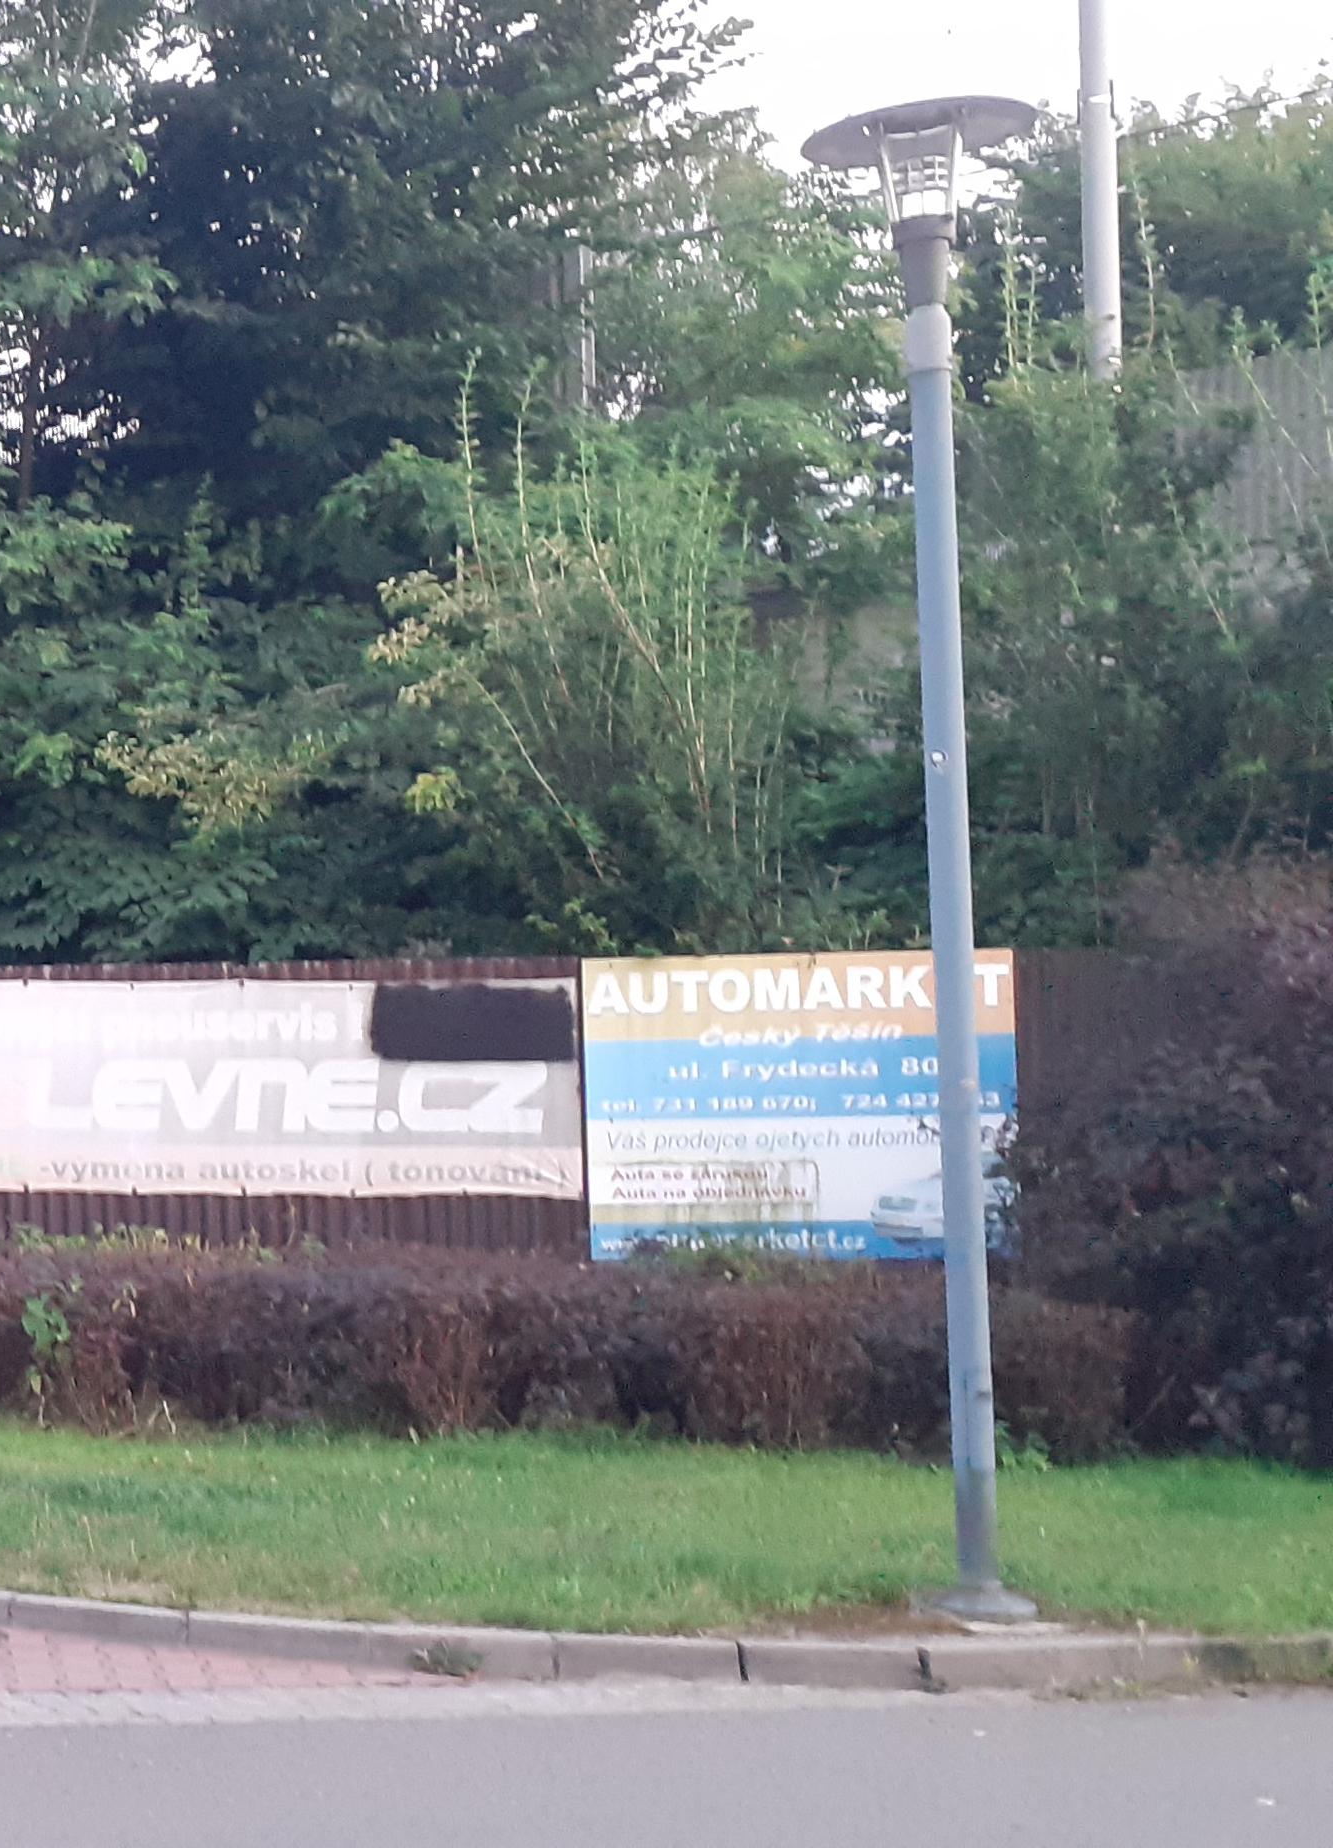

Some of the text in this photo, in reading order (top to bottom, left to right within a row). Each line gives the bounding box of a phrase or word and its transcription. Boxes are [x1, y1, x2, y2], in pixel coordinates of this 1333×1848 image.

[587, 963, 1010, 1016] AUTOMARKT
[698, 1020, 904, 1049] Český Těšín
[654, 1130, 747, 1154] prodejce
[756, 1129, 840, 1154] ojetých
[611, 1167, 656, 1182] Auta
[612, 1186, 656, 1200] Auta
[664, 1189, 685, 1200] na
